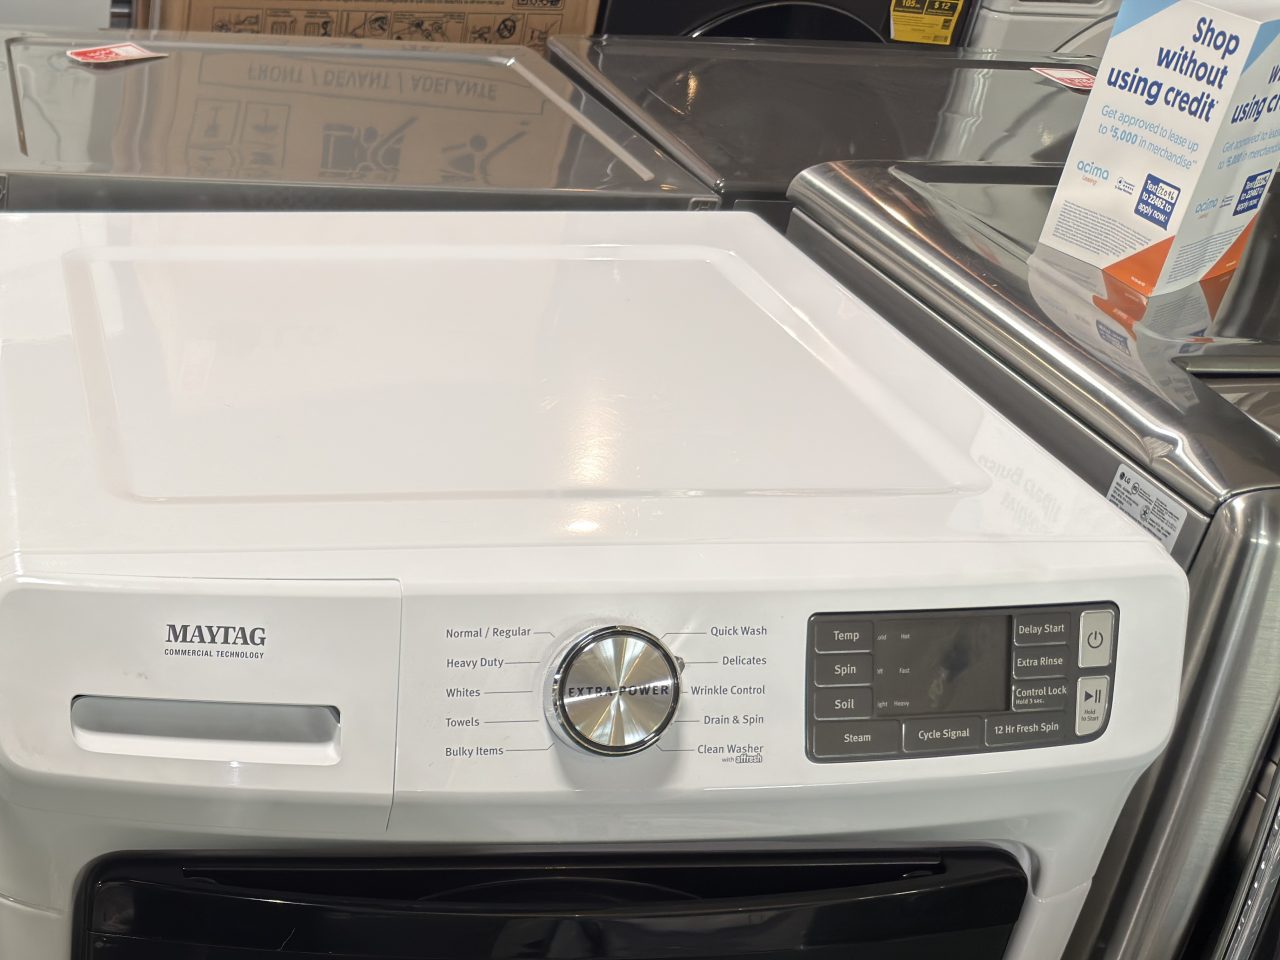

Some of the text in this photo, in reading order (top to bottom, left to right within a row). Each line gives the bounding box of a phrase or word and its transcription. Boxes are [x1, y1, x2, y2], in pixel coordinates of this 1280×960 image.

[1192, 16, 1240, 60] Shop
[1156, 45, 1228, 90] without
[1107, 67, 1163, 106] using
[1231, 94, 1268, 124] using
[1098, 122, 1108, 136] to
[1138, 135, 1147, 149] in
[1101, 105, 1200, 154] Get approved to lease up
[1077, 159, 1110, 182] acima
[1146, 180, 1158, 193] Text
[1142, 192, 1149, 200] to
[1164, 202, 1172, 213] to
[1138, 202, 1153, 220] apply
[165, 623, 267, 647] MAYTAG
[446, 628, 483, 639] Normal
[492, 627, 531, 640] Regular
[710, 626, 767, 638] Quick Wash
[1019, 623, 1065, 635] Delay Start
[833, 630, 860, 642] Temp
[164, 648, 264, 659] COMMERCIAL TECHNOLOGY
[446, 657, 504, 669] Heavy Duty
[722, 655, 767, 666] Delicates
[1017, 656, 1063, 667] Extra Rinse
[834, 664, 857, 676] Spin
[446, 687, 480, 698] Whites
[568, 685, 670, 697] EXTRA POWER
[691, 685, 765, 696] Wrinkle Control
[1016, 685, 1067, 697] Control Lock
[834, 699, 855, 709] Soil
[445, 717, 480, 728] Towels
[704, 714, 764, 726] Drain & Spin
[918, 728, 970, 740] Cycle Signal
[994, 722, 1059, 734] 12 Hr Fresh Spin
[844, 733, 871, 743] Steam
[445, 746, 504, 758] Bulky Items
[697, 744, 764, 754] Clean Washer
[722, 756, 734, 764] with
